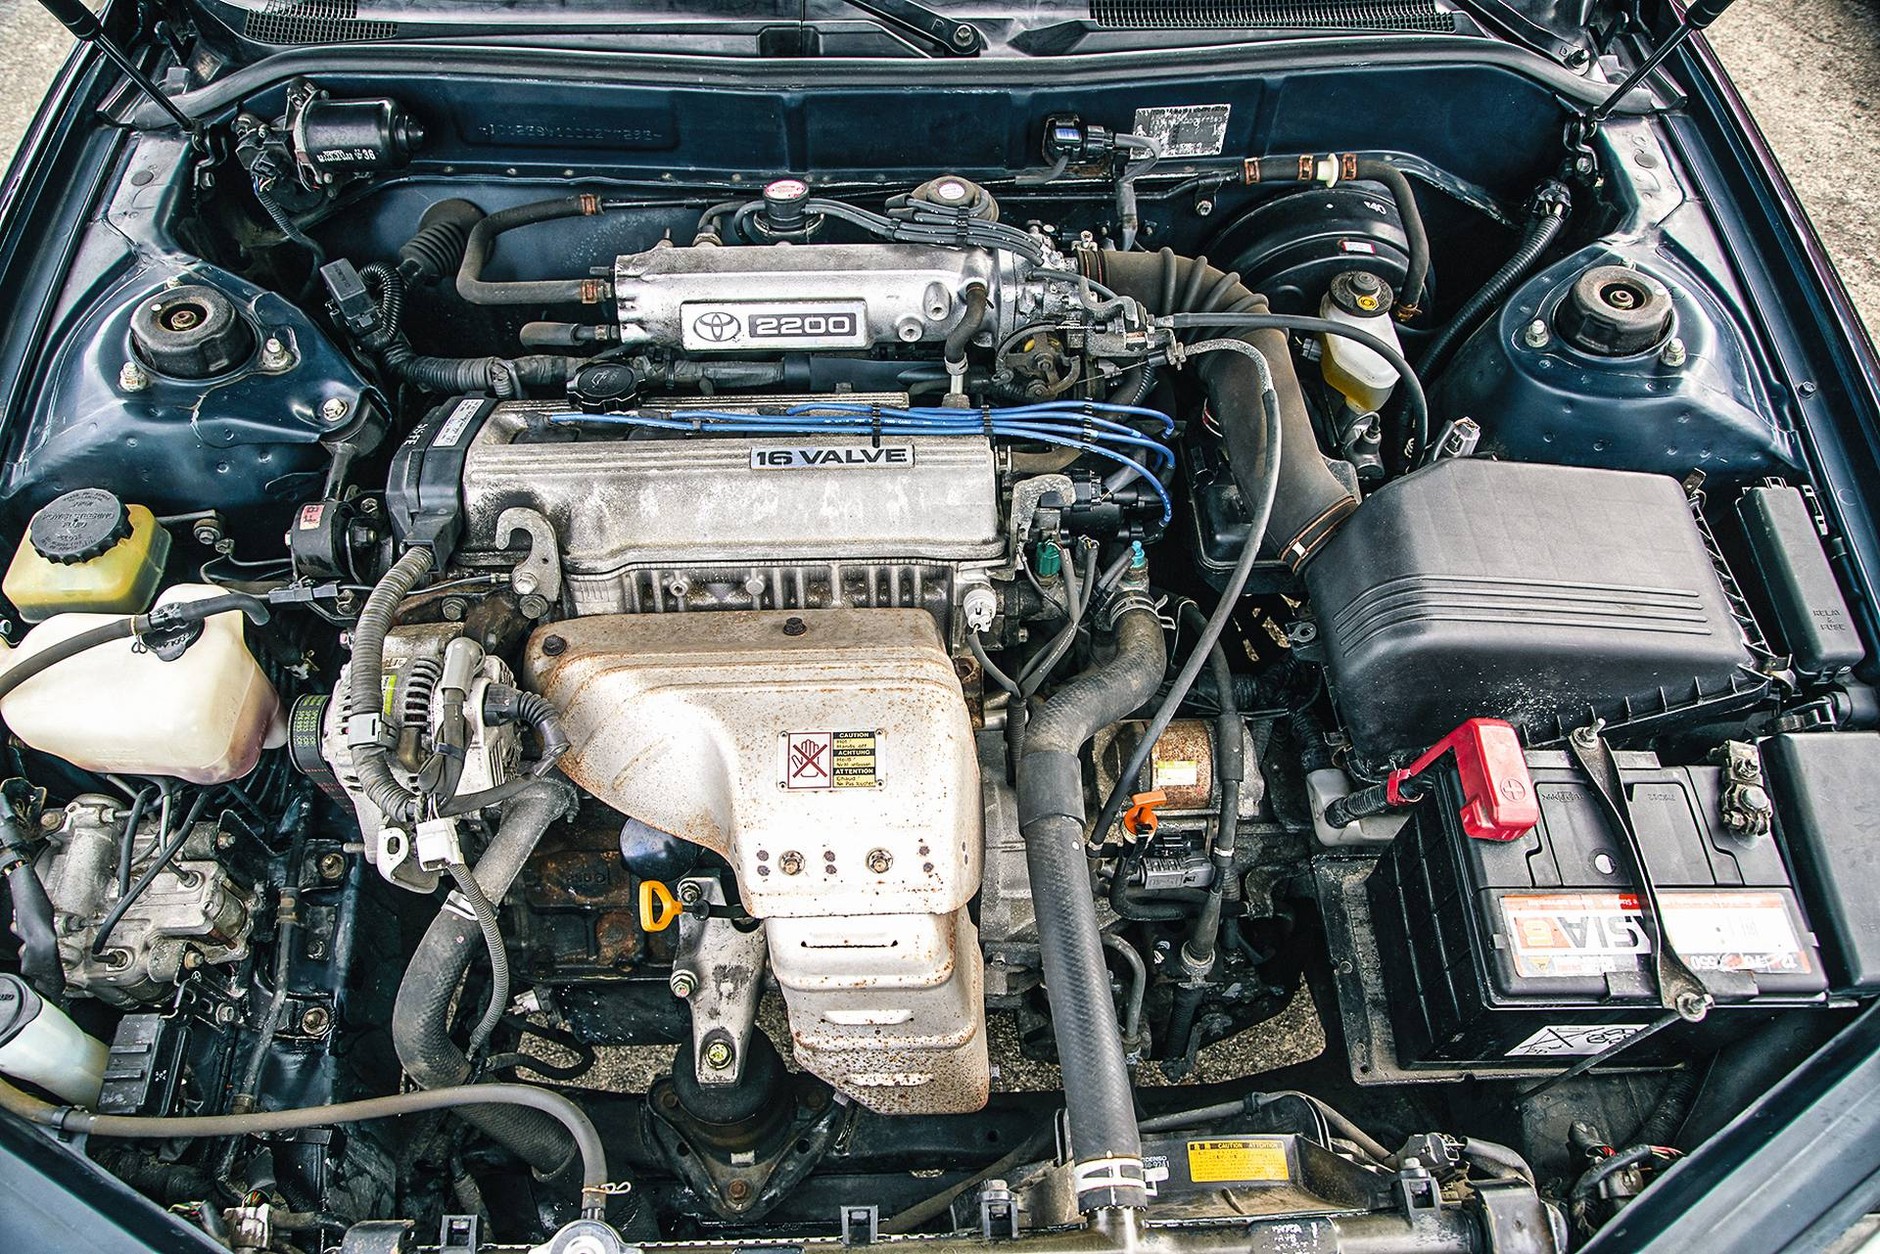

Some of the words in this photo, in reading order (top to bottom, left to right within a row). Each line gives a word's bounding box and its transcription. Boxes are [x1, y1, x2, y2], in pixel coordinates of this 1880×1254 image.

[755, 316, 850, 335] 2200
[756, 450, 793, 466] 16
[799, 448, 908, 465] VALVE
[1557, 915, 1650, 948] SIA
